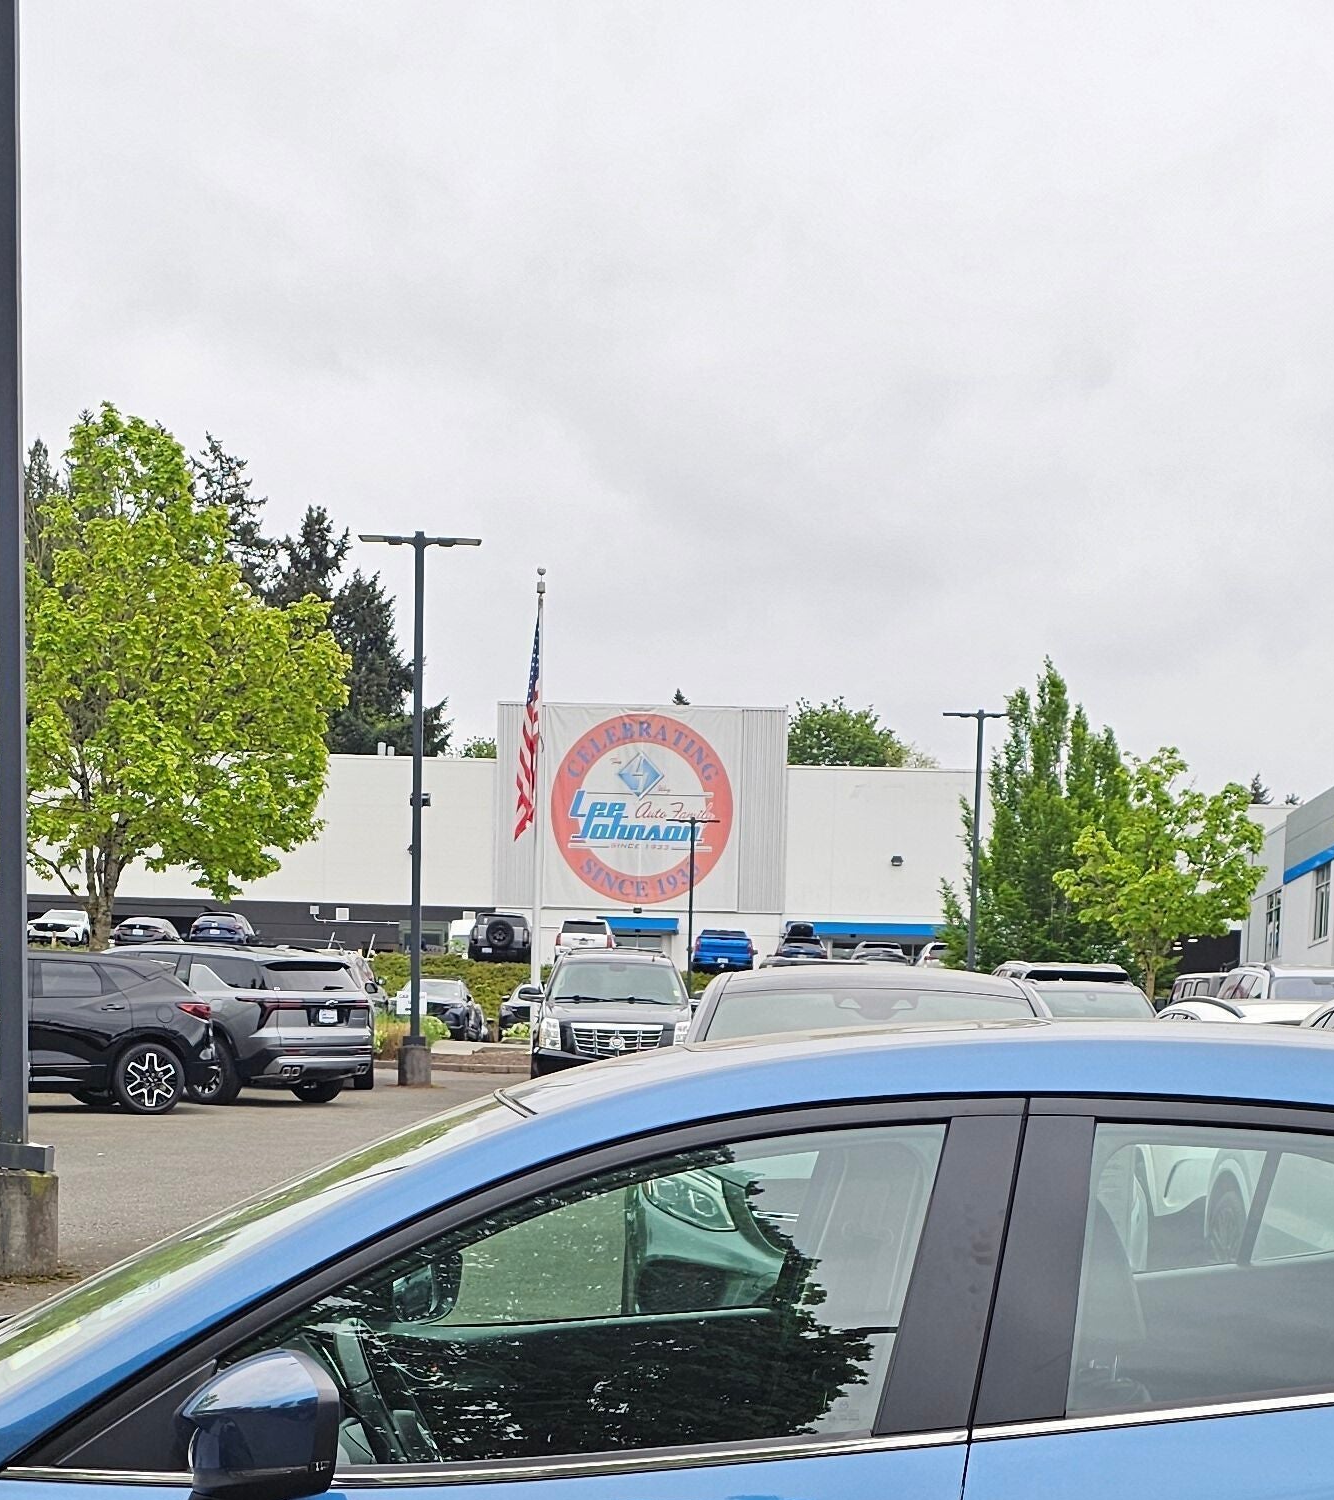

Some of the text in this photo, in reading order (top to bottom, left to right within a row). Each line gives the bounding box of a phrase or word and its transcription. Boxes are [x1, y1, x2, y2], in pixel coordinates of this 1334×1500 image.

[568, 721, 719, 781] CELEBRATING
[570, 790, 629, 818] Lee
[635, 801, 667, 819] Auto
[571, 813, 703, 842] Johnson
[581, 858, 649, 898] SINCE
